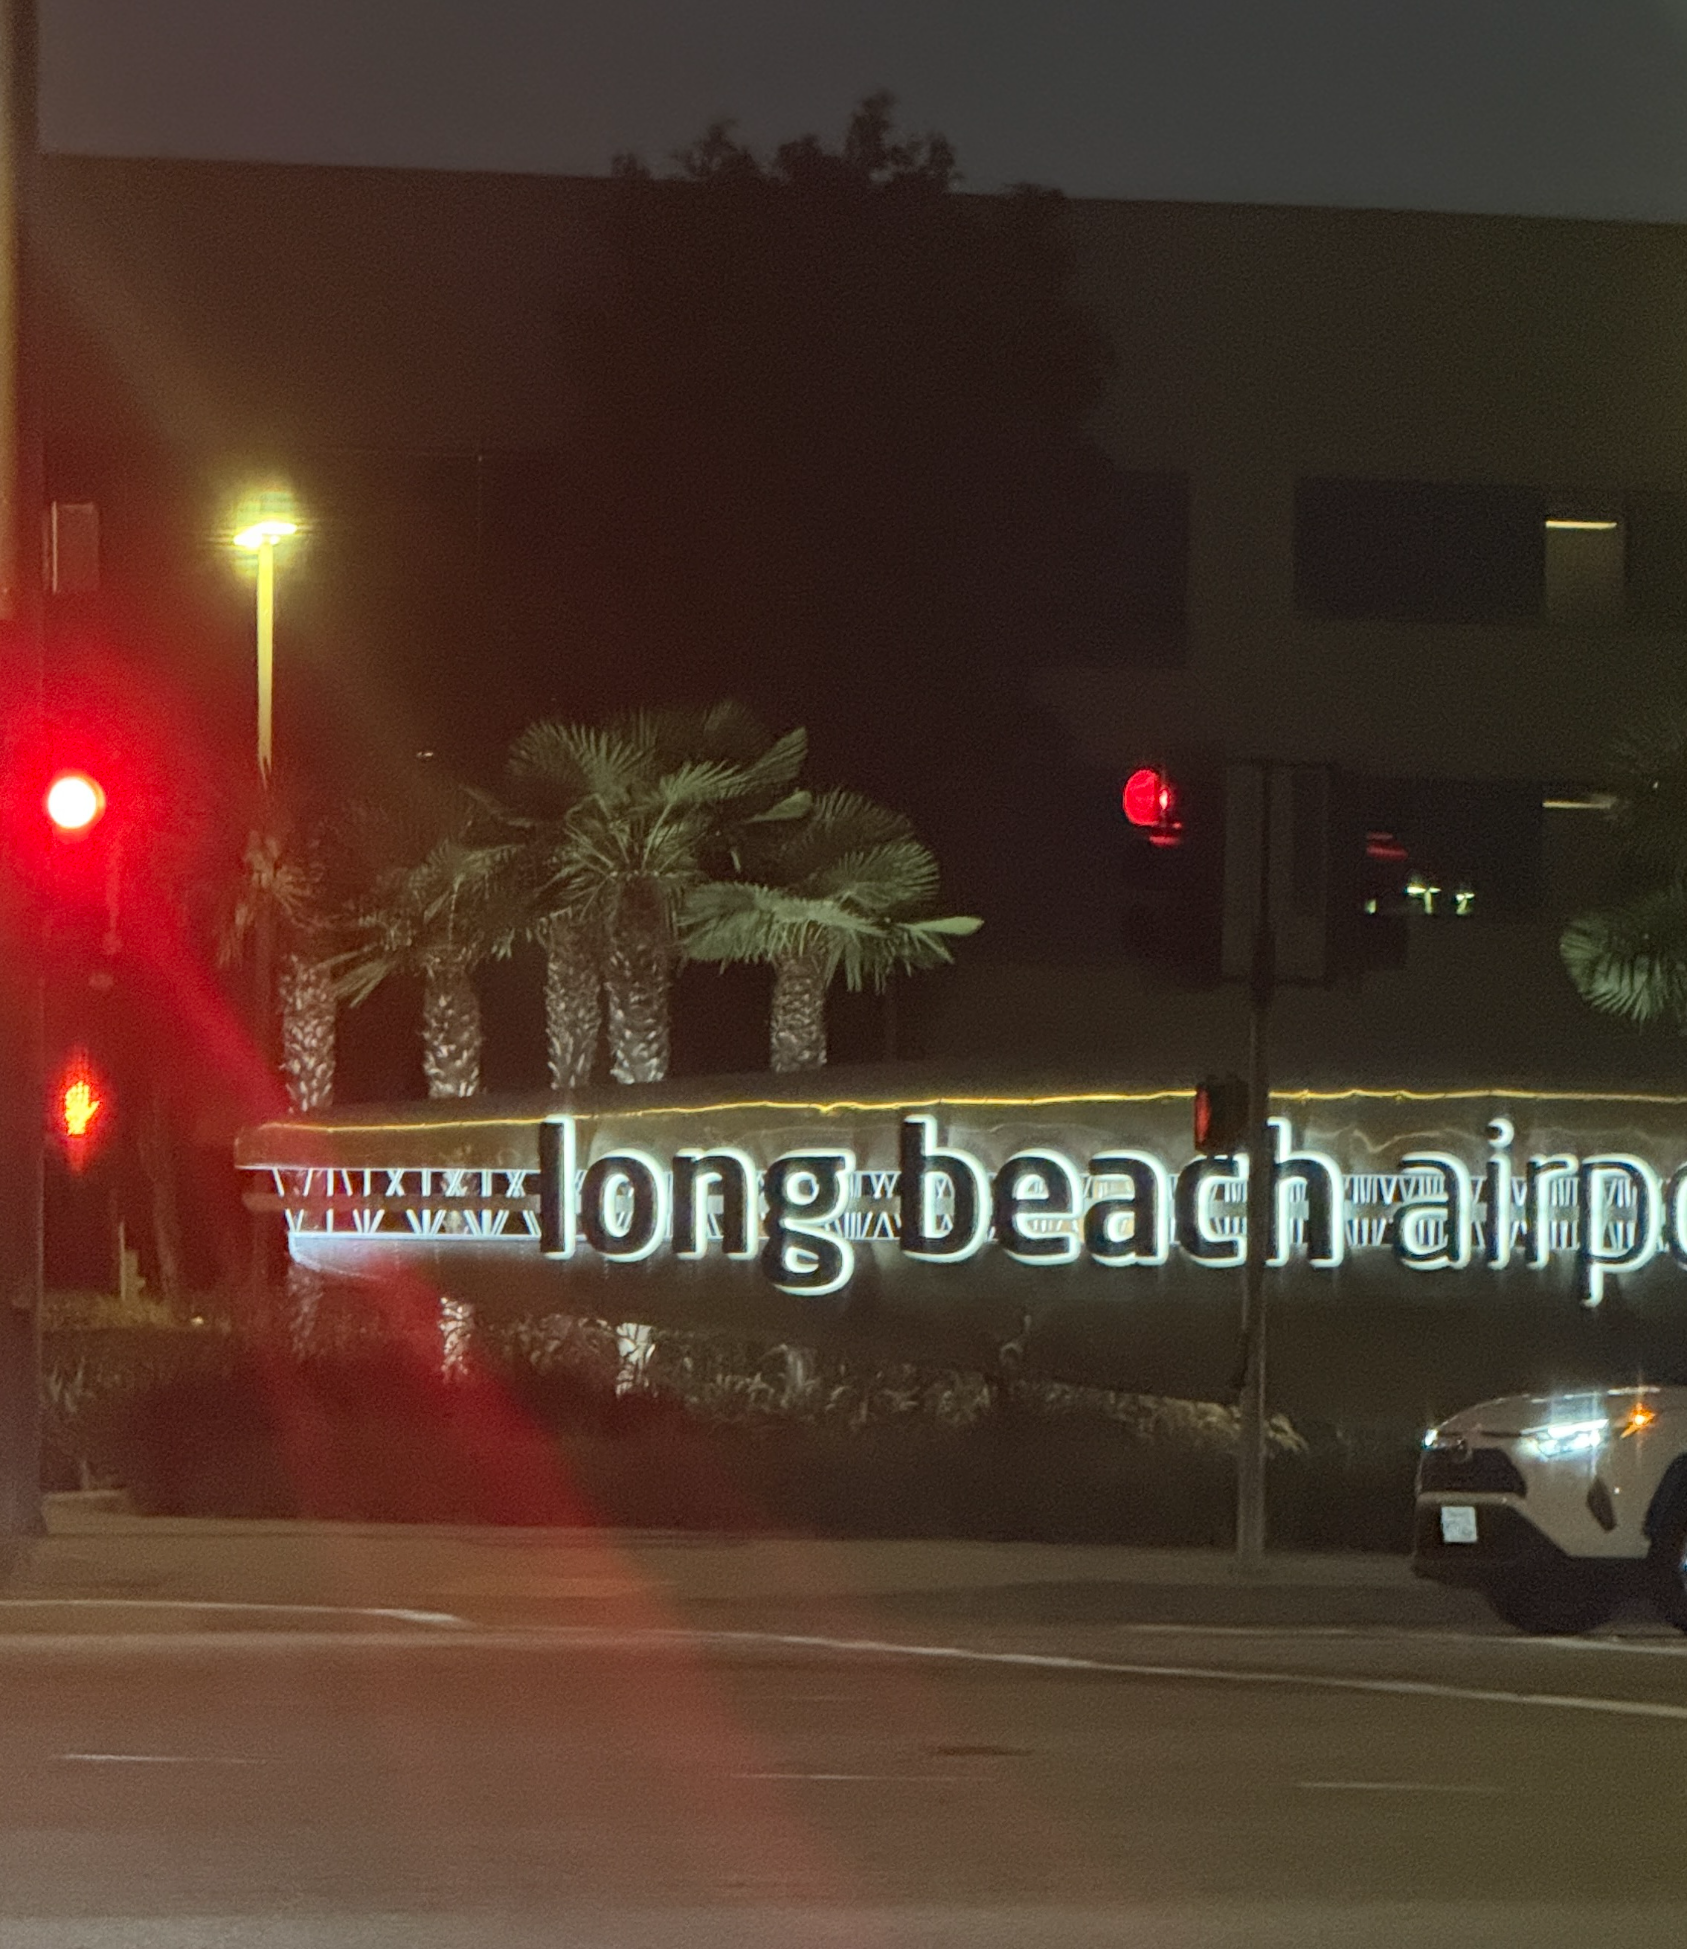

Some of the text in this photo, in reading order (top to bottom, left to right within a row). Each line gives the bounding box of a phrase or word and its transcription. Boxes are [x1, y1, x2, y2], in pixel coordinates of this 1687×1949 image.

[540, 1114, 1687, 1308] long beach airp
